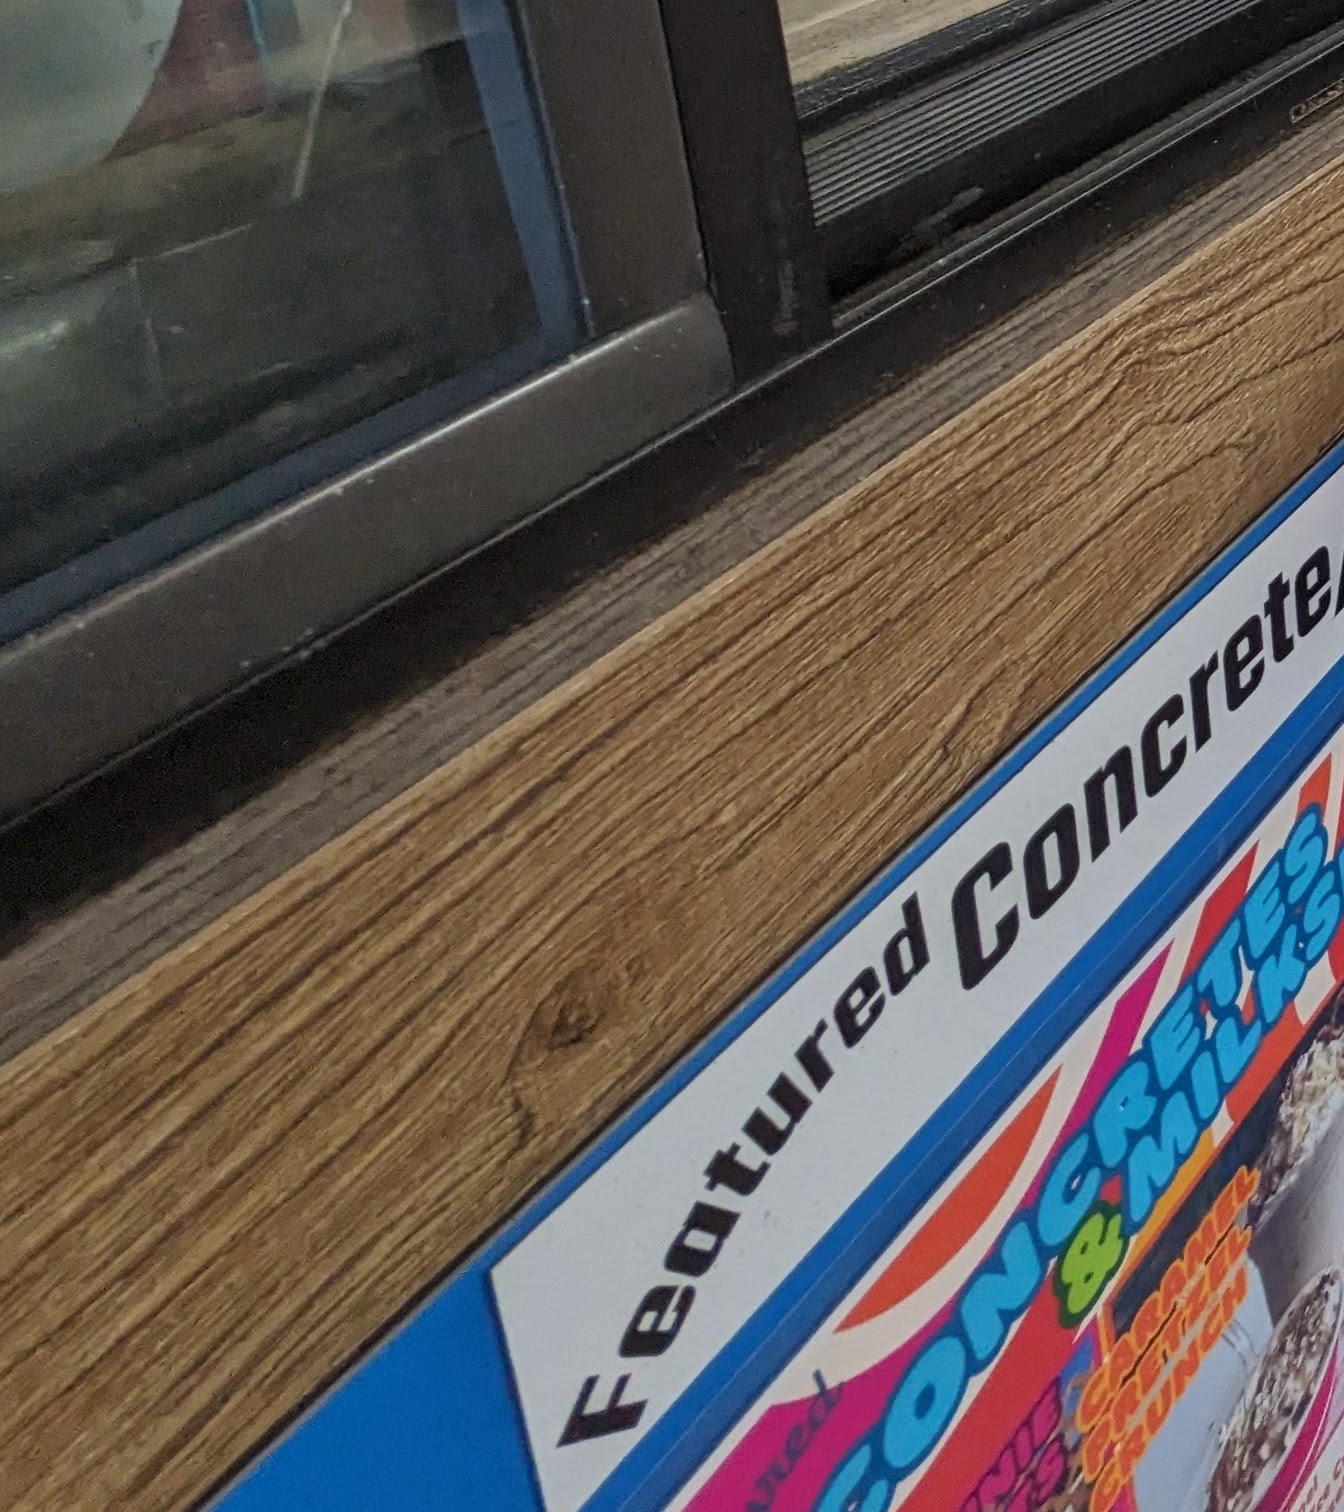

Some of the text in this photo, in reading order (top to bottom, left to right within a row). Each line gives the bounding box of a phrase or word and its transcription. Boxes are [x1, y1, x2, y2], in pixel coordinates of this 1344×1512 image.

[553, 903, 931, 1449] Featured
[812, 808, 1328, 1512] CONCRETES
[1061, 1212, 1125, 1315] &
[1075, 1165, 1260, 1434] CARAMEL
[1082, 1226, 1252, 1481] PRETZEL
[1088, 1268, 1248, 1512] CRUNCH
